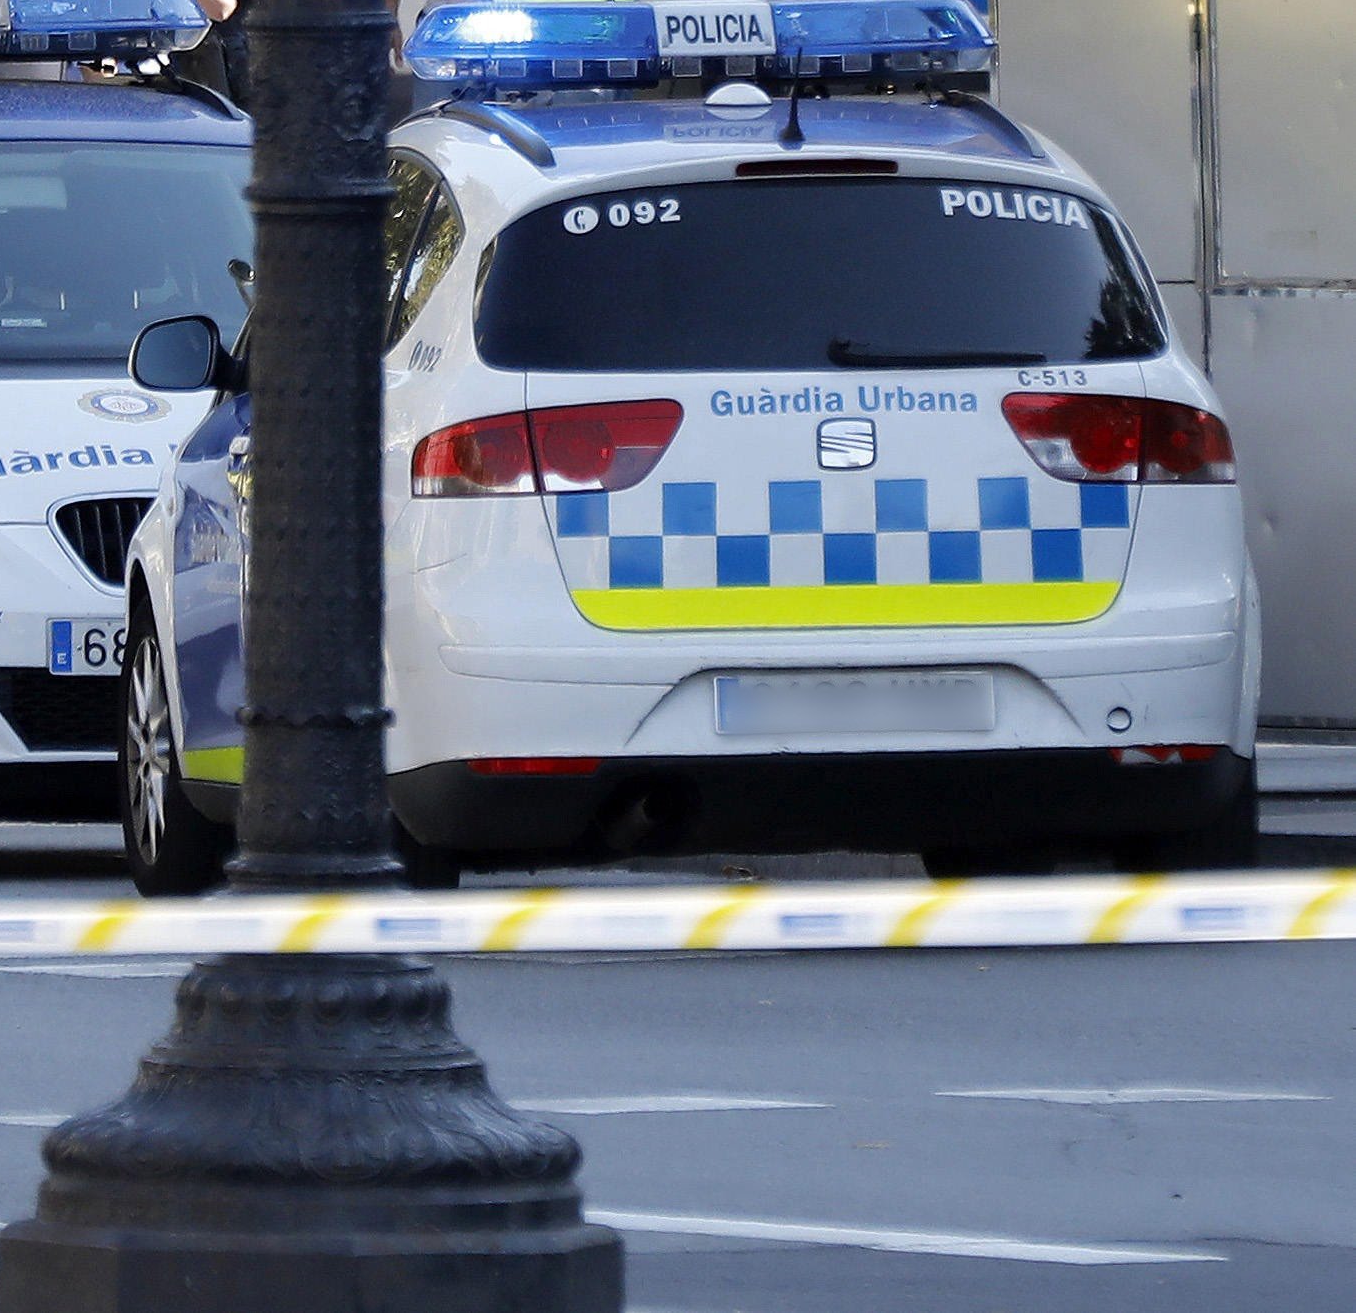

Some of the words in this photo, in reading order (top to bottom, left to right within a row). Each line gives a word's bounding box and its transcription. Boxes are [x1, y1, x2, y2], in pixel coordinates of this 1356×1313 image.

[666, 14, 764, 45] POLICIA
[608, 199, 682, 228] 092
[941, 189, 1088, 229] POLICIA
[1017, 370, 1088, 387] C-513
[710, 387, 844, 416] Guàrdia
[858, 386, 978, 414] Urbana
[57, 652, 67, 665] E
